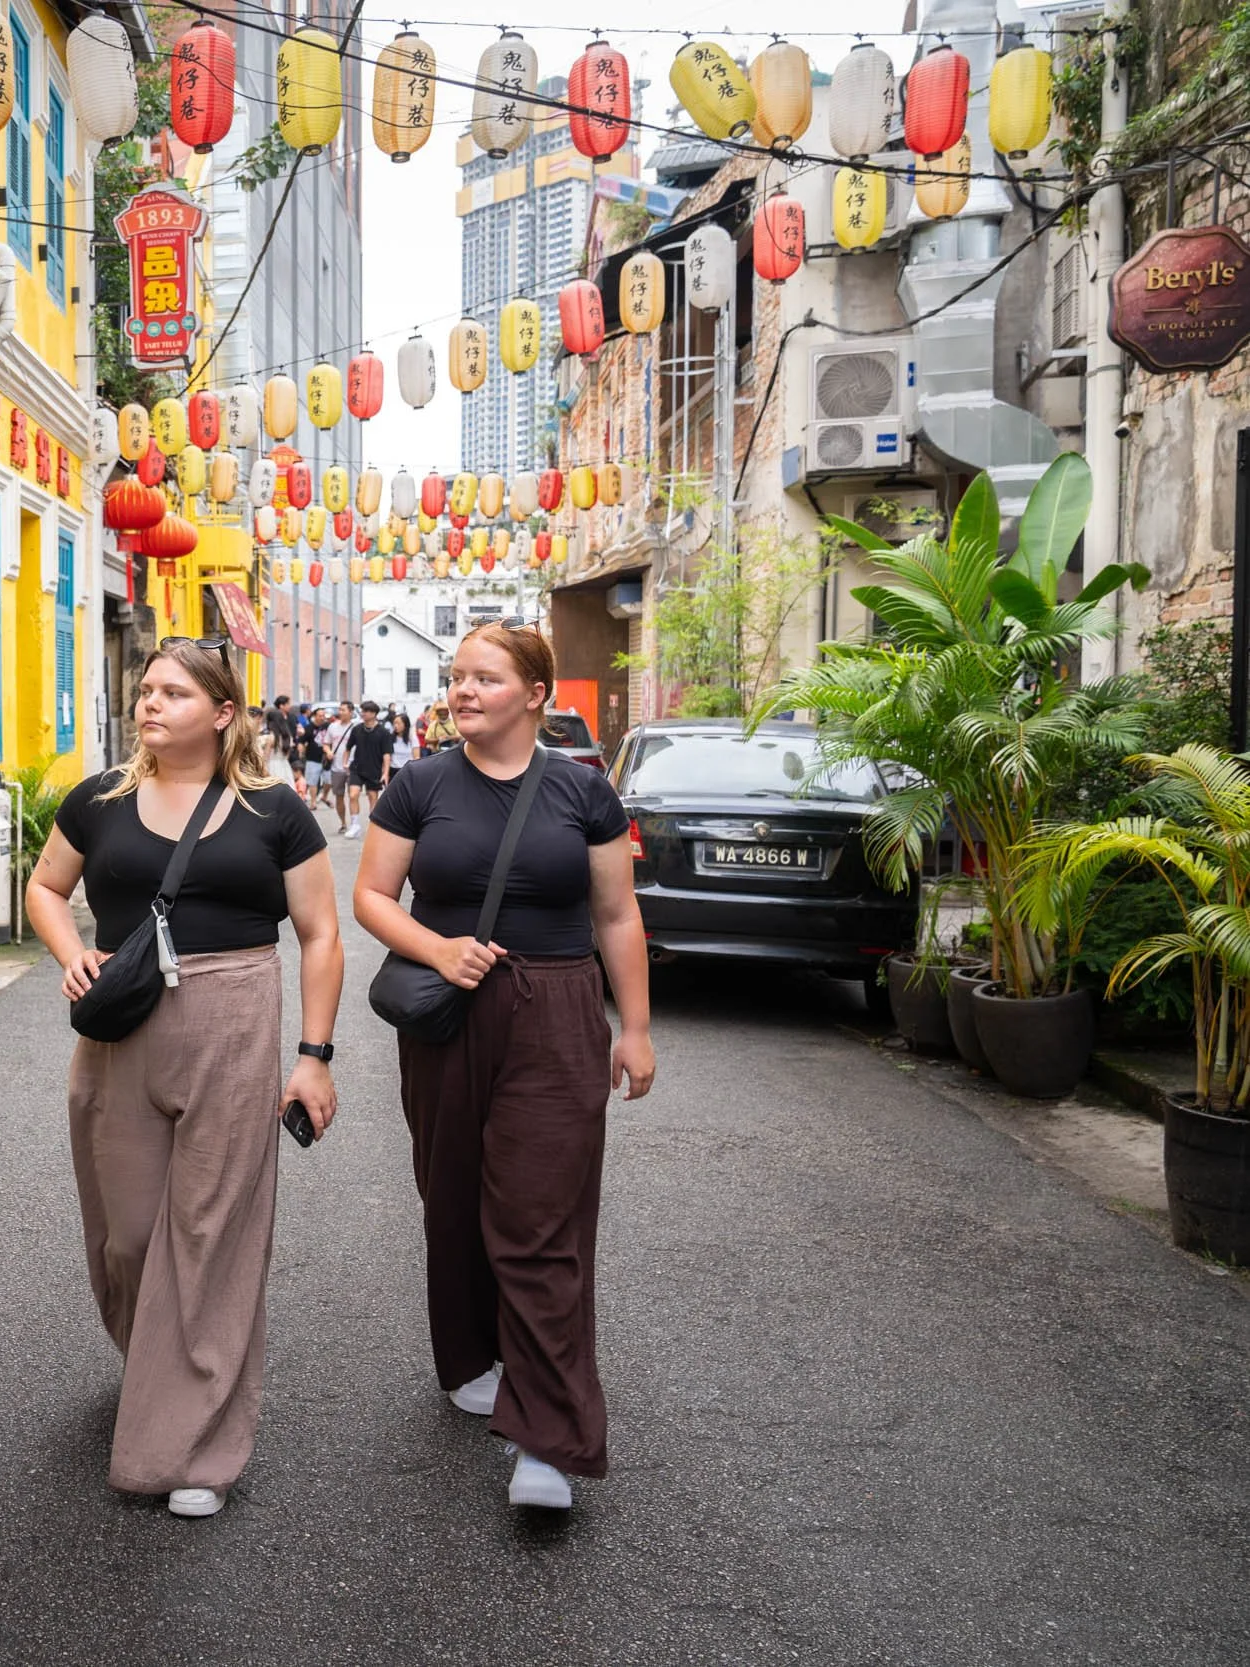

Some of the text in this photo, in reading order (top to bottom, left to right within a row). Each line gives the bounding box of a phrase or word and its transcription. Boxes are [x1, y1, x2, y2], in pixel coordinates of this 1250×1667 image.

[177, 43, 204, 121] 鬼仔巷
[408, 50, 431, 128] 鬼仔巷
[499, 51, 526, 126] 鬼仔巷
[693, 48, 744, 100] 鬼仔巷
[137, 209, 184, 228] 1893
[846, 173, 869, 229] 鬼仔巷
[783, 204, 800, 262] 鬼仔巷
[629, 263, 649, 316] 鬼仔巷
[689, 238, 708, 292] 鬼仔巷
[1145, 260, 1236, 295] Beryl's
[519, 309, 535, 358] 鬼仔巷
[1148, 319, 1238, 331] CHOCOLATE
[1168, 330, 1215, 339] STORY
[465, 329, 482, 377] 鬼仔巷
[716, 846, 808, 865] WA 4866 W
